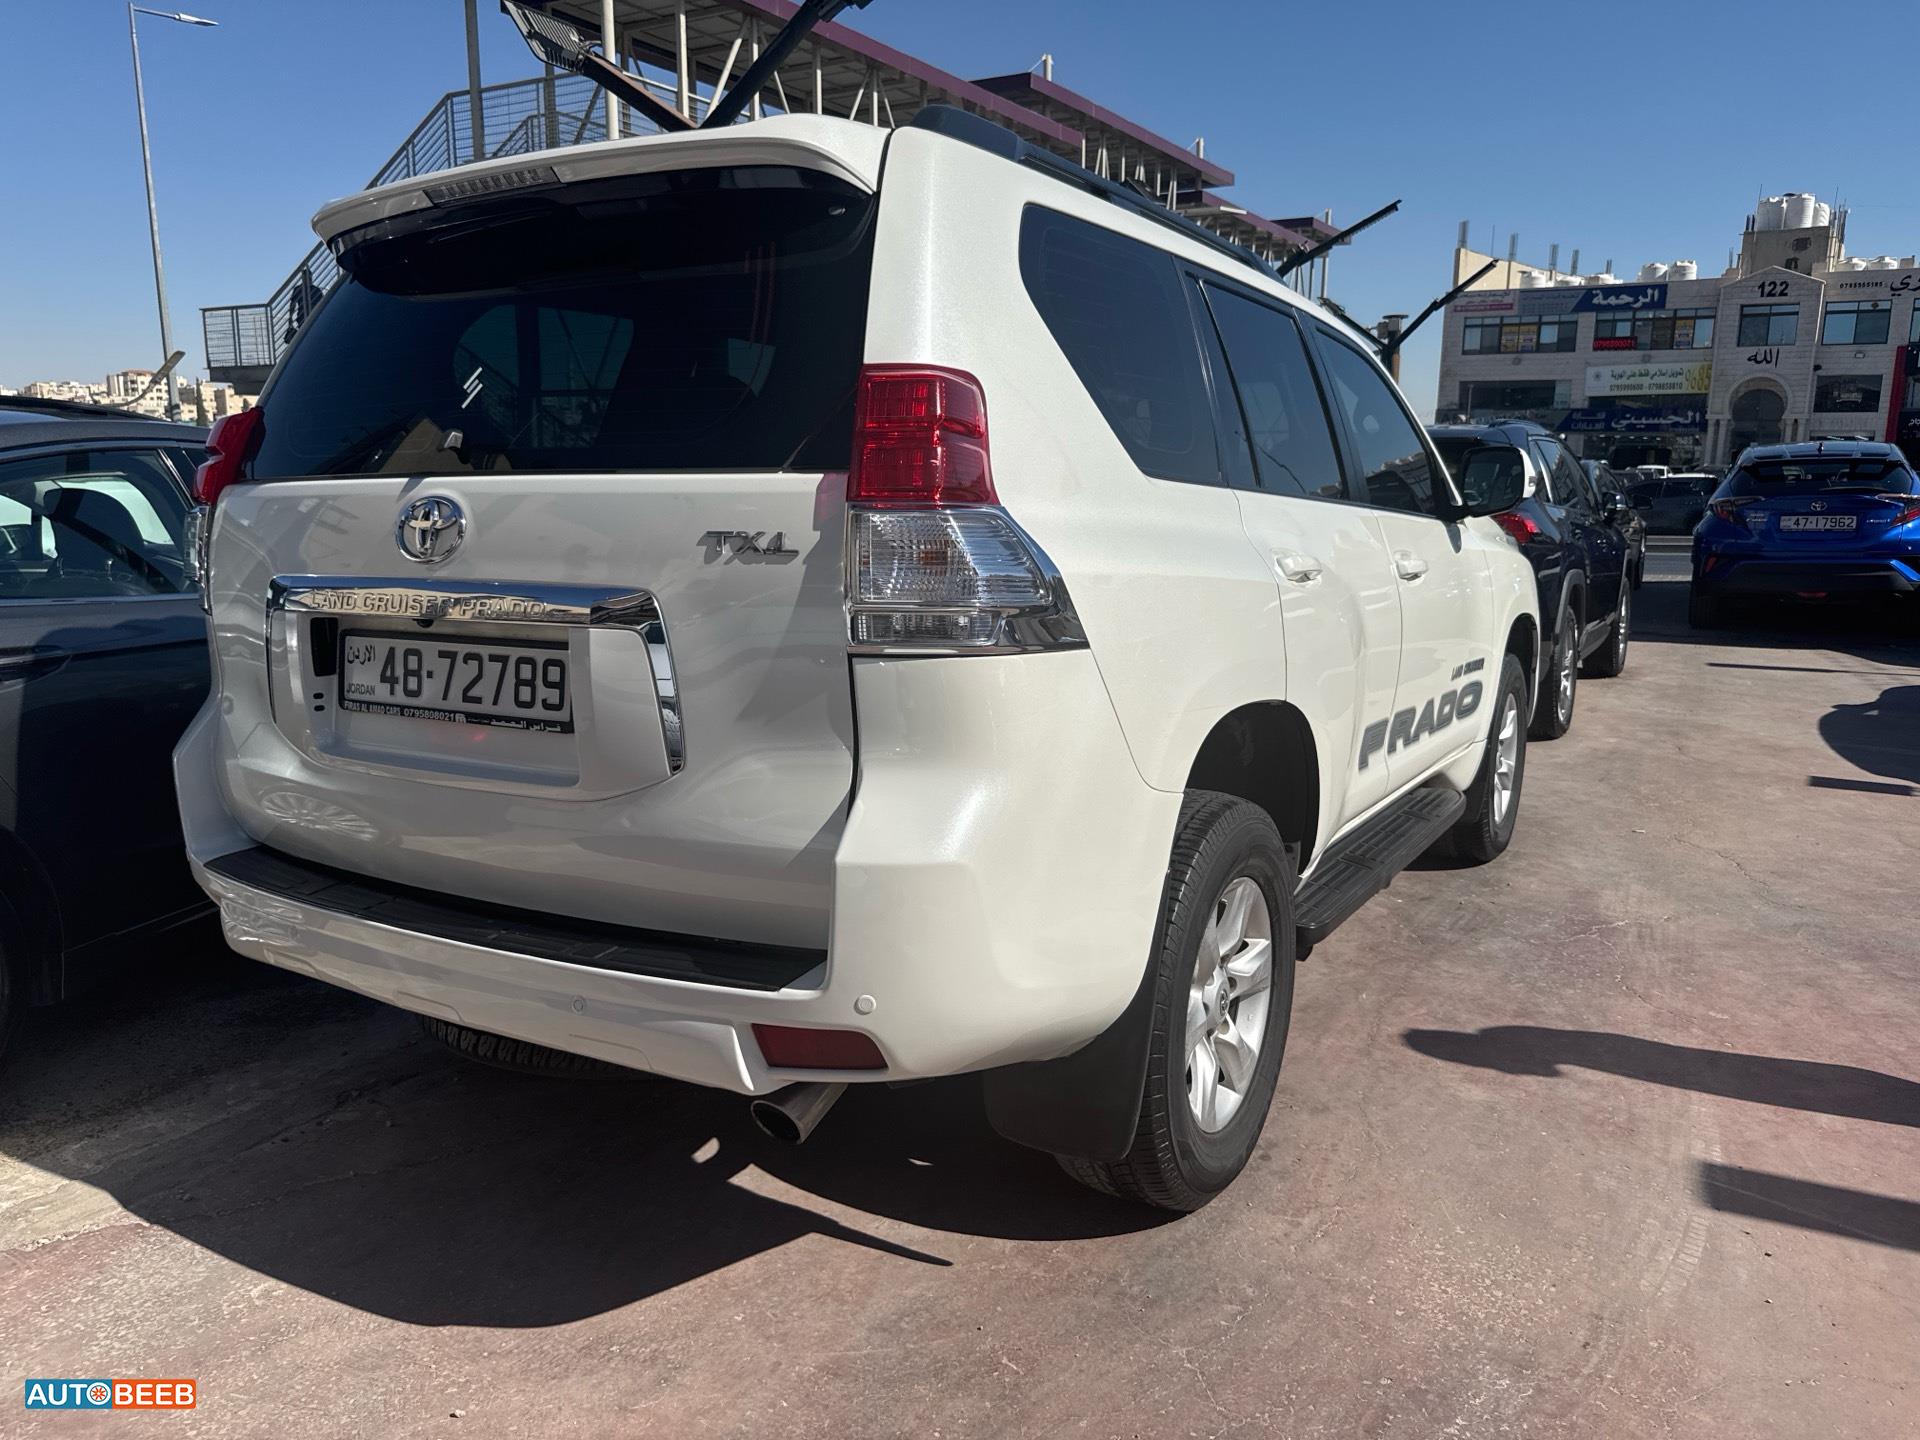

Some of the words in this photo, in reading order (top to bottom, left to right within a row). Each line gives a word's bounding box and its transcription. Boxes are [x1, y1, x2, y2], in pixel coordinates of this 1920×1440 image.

[1592, 288, 1660, 308] الرحمة
[1757, 281, 1789, 297] 122
[1747, 347, 1779, 368] الله
[1611, 410, 1700, 431] الحسيني
[312, 590, 357, 610] LAND
[364, 592, 452, 617] CRUISER
[460, 597, 547, 618] PRADO
[346, 683, 376, 696] JORDAN
[344, 700, 361, 711] FIRAS
[386, 706, 401, 716] CARS
[1358, 679, 1483, 772] PRADO
